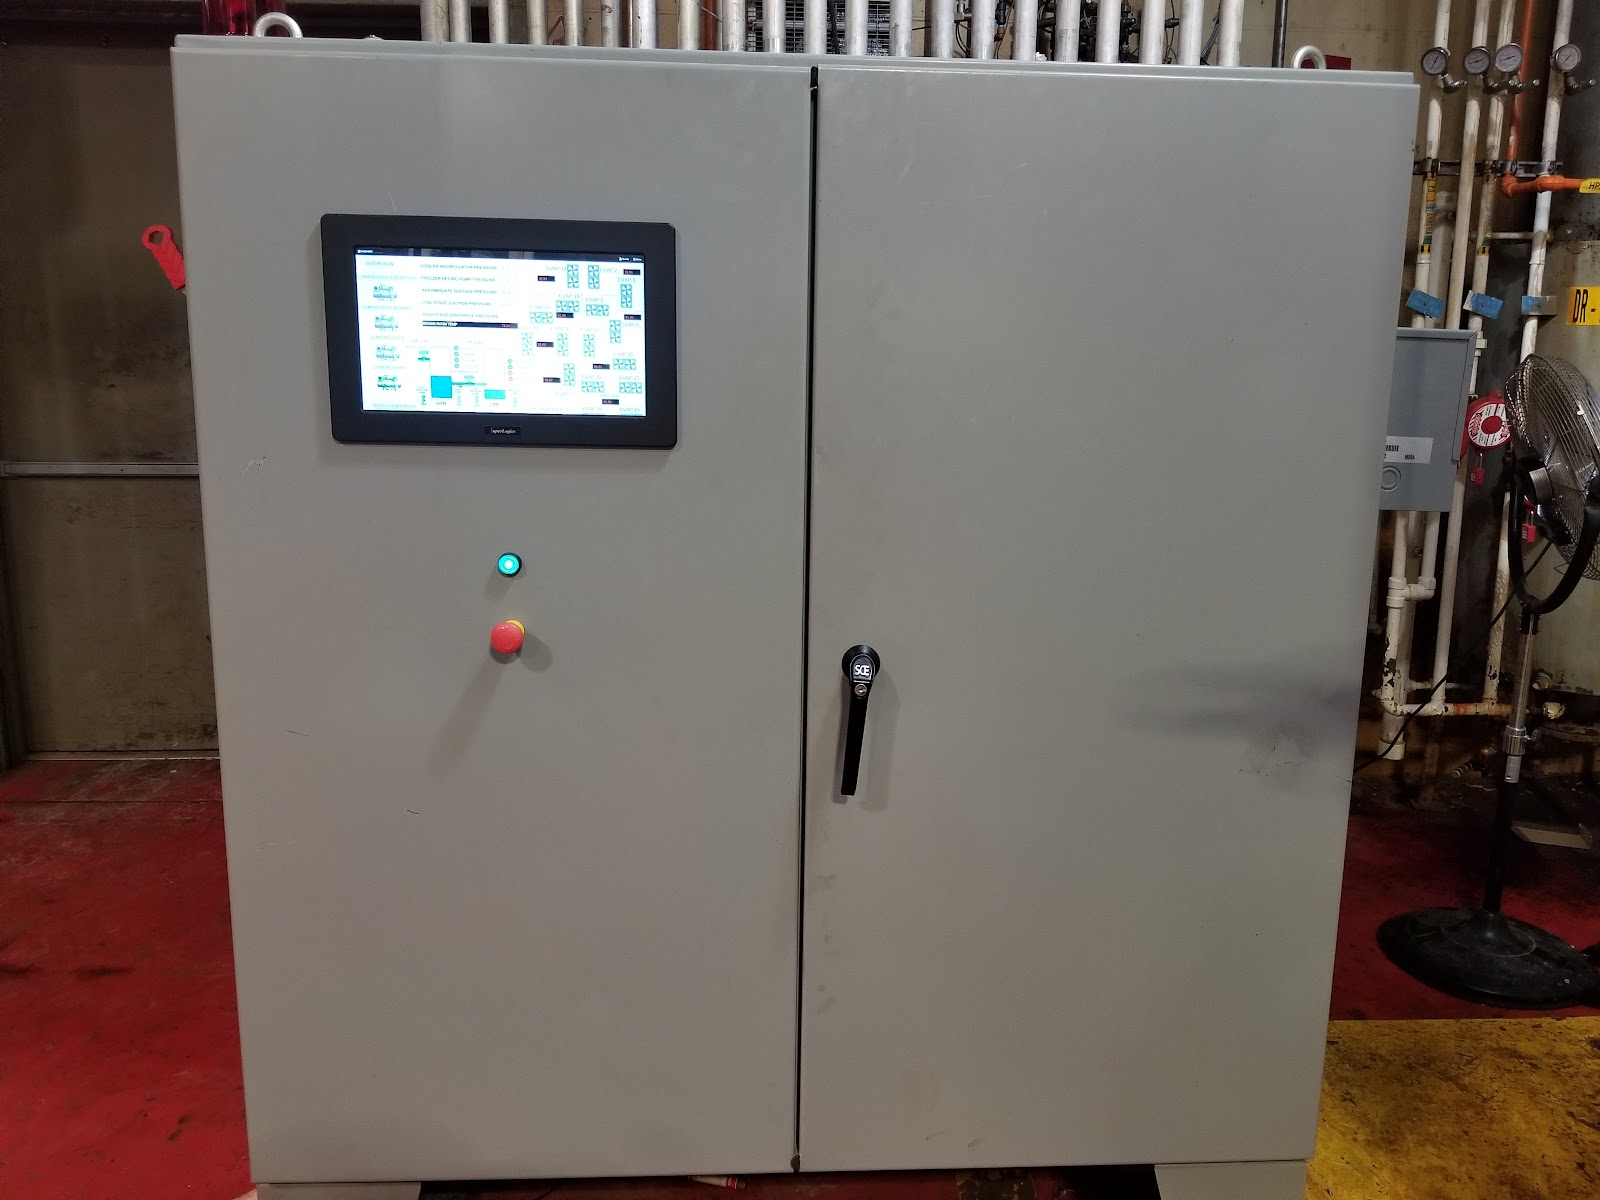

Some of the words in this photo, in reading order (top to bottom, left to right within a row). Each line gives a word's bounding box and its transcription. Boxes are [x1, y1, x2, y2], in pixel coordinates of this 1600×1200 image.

[1588, 181, 1600, 190] HP
[1572, 288, 1588, 322] DR
[854, 664, 870, 676] SCE
